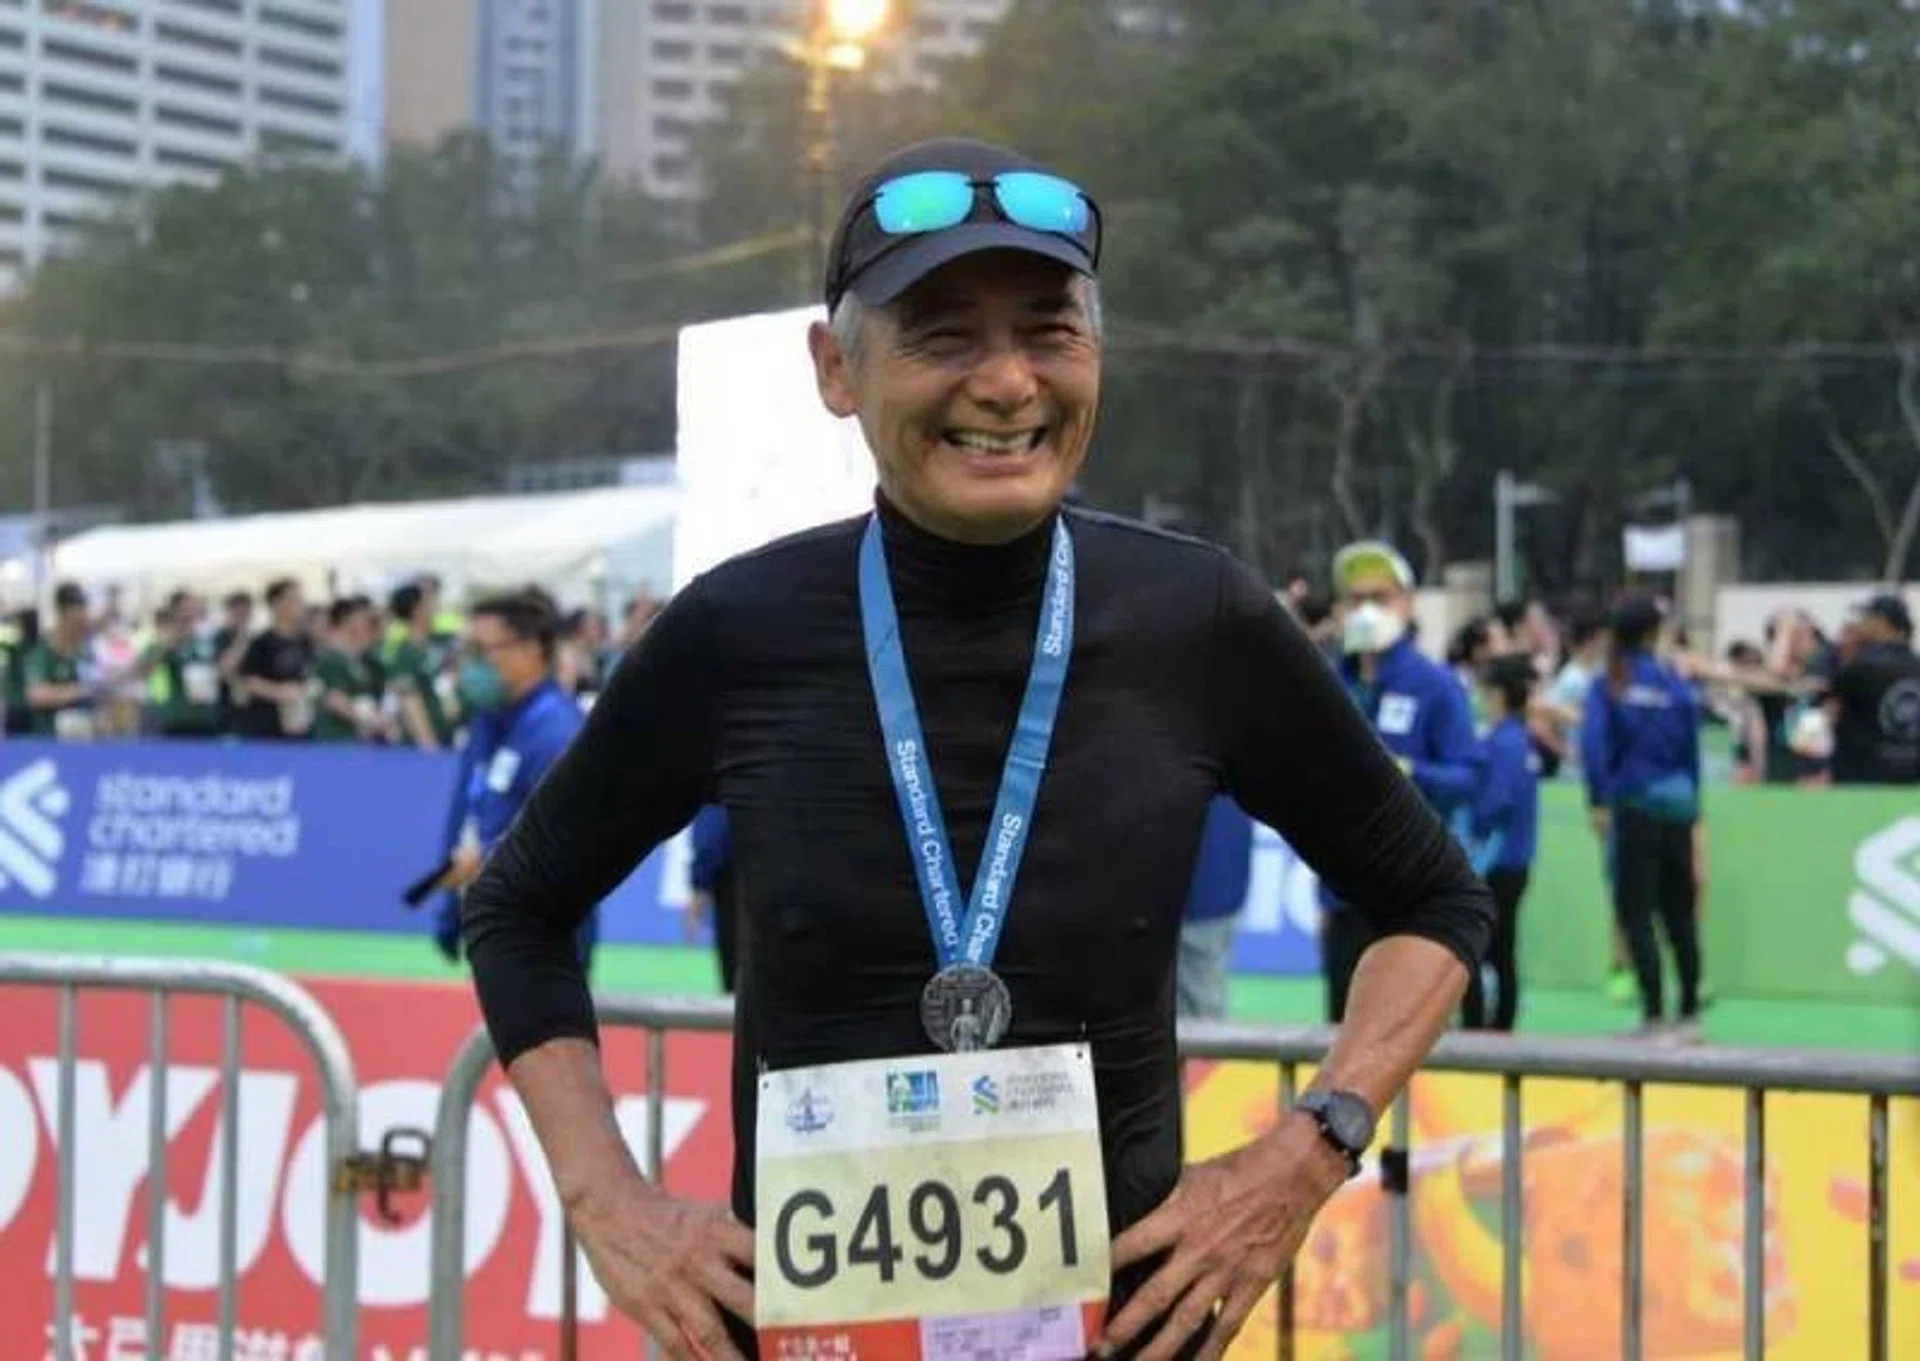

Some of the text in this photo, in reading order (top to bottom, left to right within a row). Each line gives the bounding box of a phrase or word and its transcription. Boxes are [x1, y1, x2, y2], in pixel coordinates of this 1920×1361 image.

[1040, 567, 1070, 656] Standard
[88, 813, 299, 857] chartered
[95, 769, 293, 817] standard
[897, 739, 961, 946] Standard Chartered
[981, 813, 1023, 910] Standard
[775, 1167, 1079, 1290] G4931
